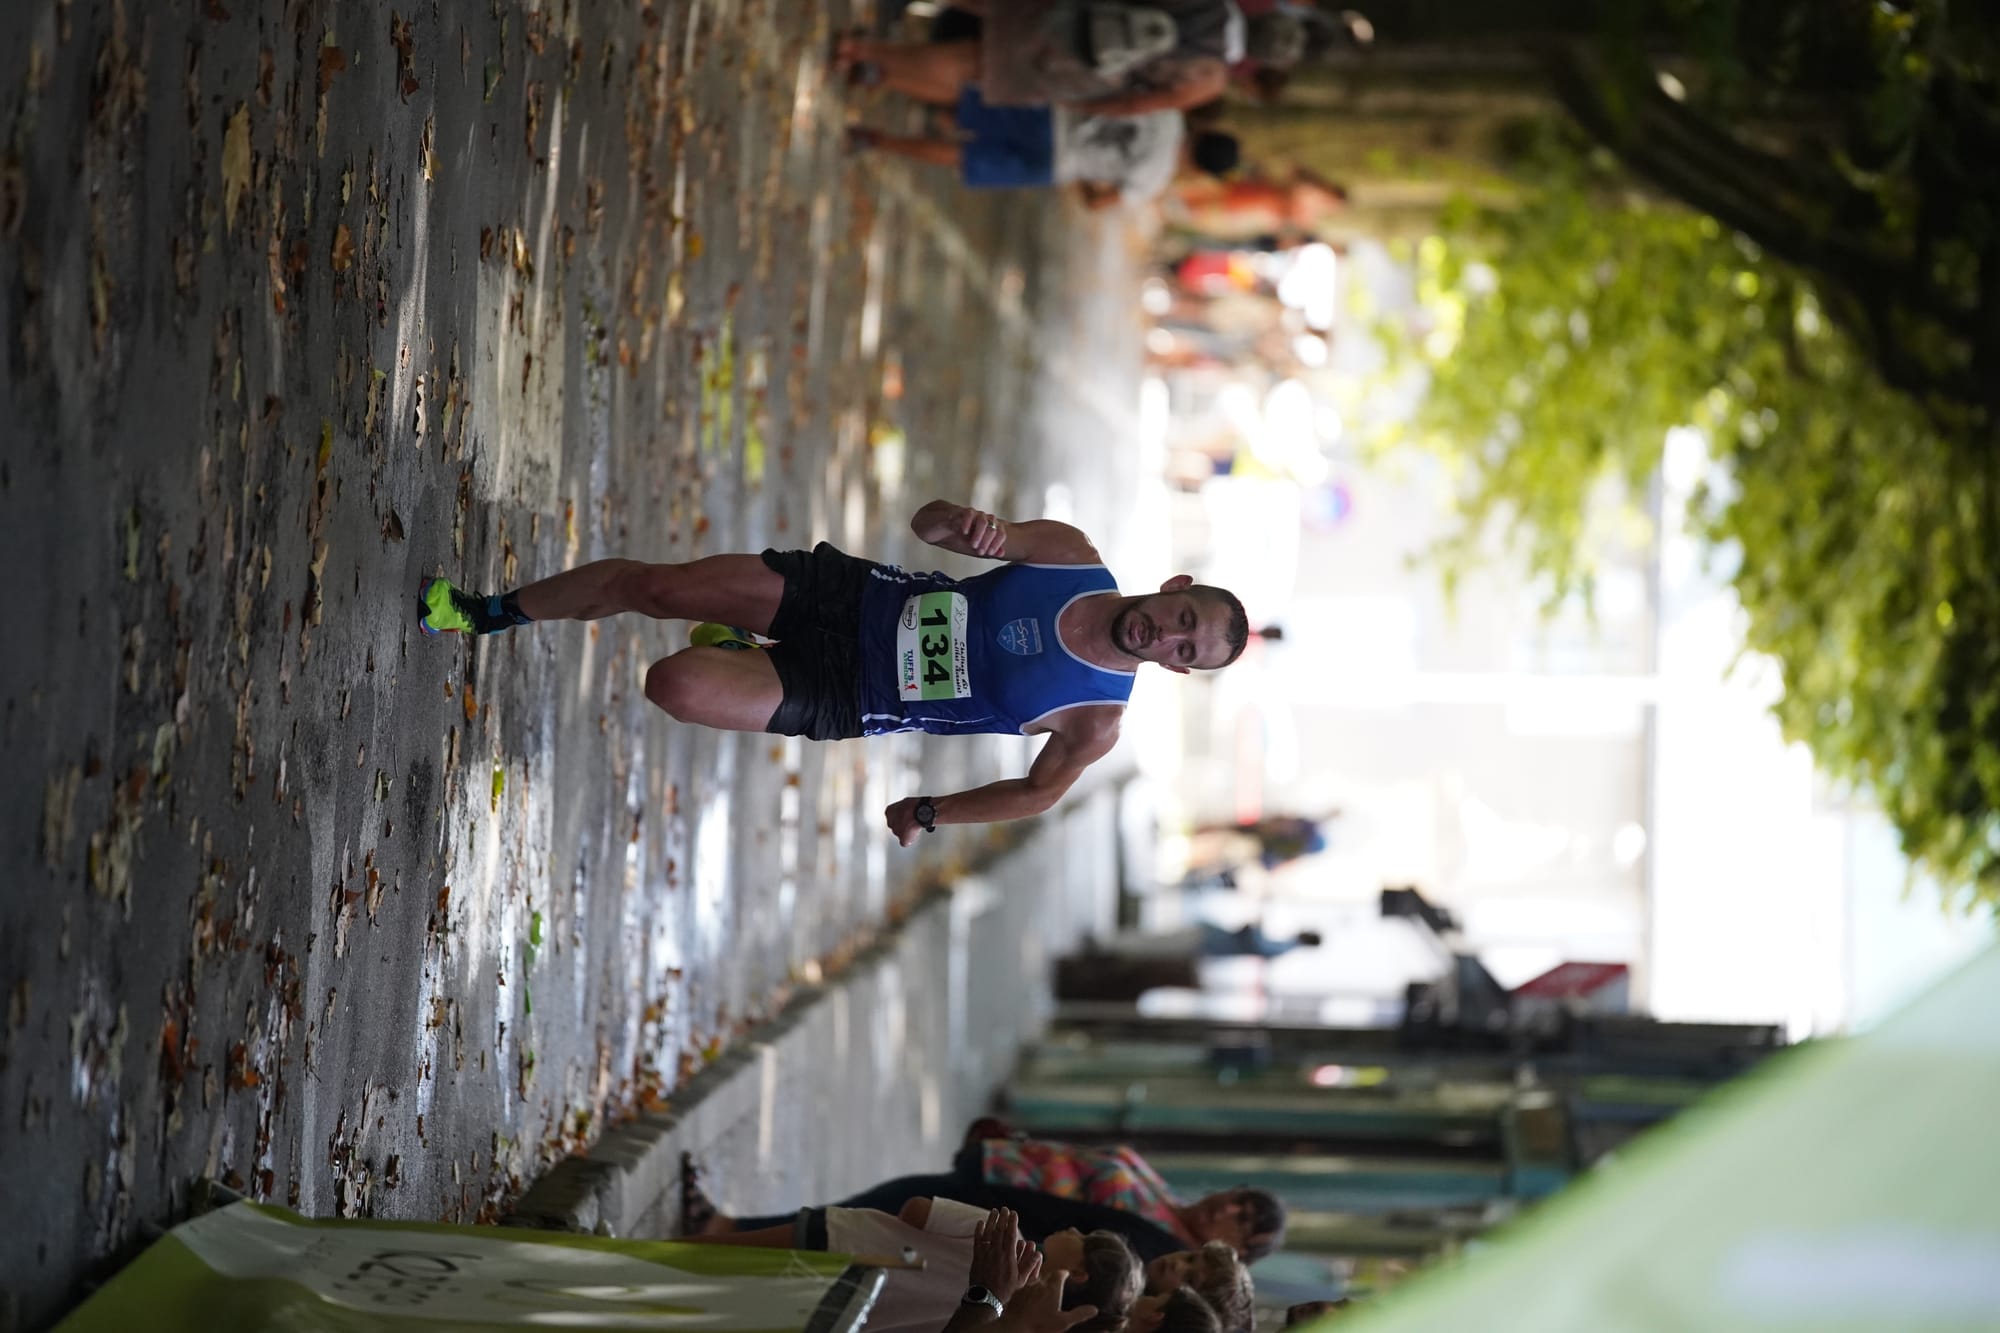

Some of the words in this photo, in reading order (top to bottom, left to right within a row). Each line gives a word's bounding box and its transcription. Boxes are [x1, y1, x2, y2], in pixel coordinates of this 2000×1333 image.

[920, 608, 950, 685] 134
[958, 641, 967, 675] Challenge
[906, 649, 914, 681] TUFF'S
